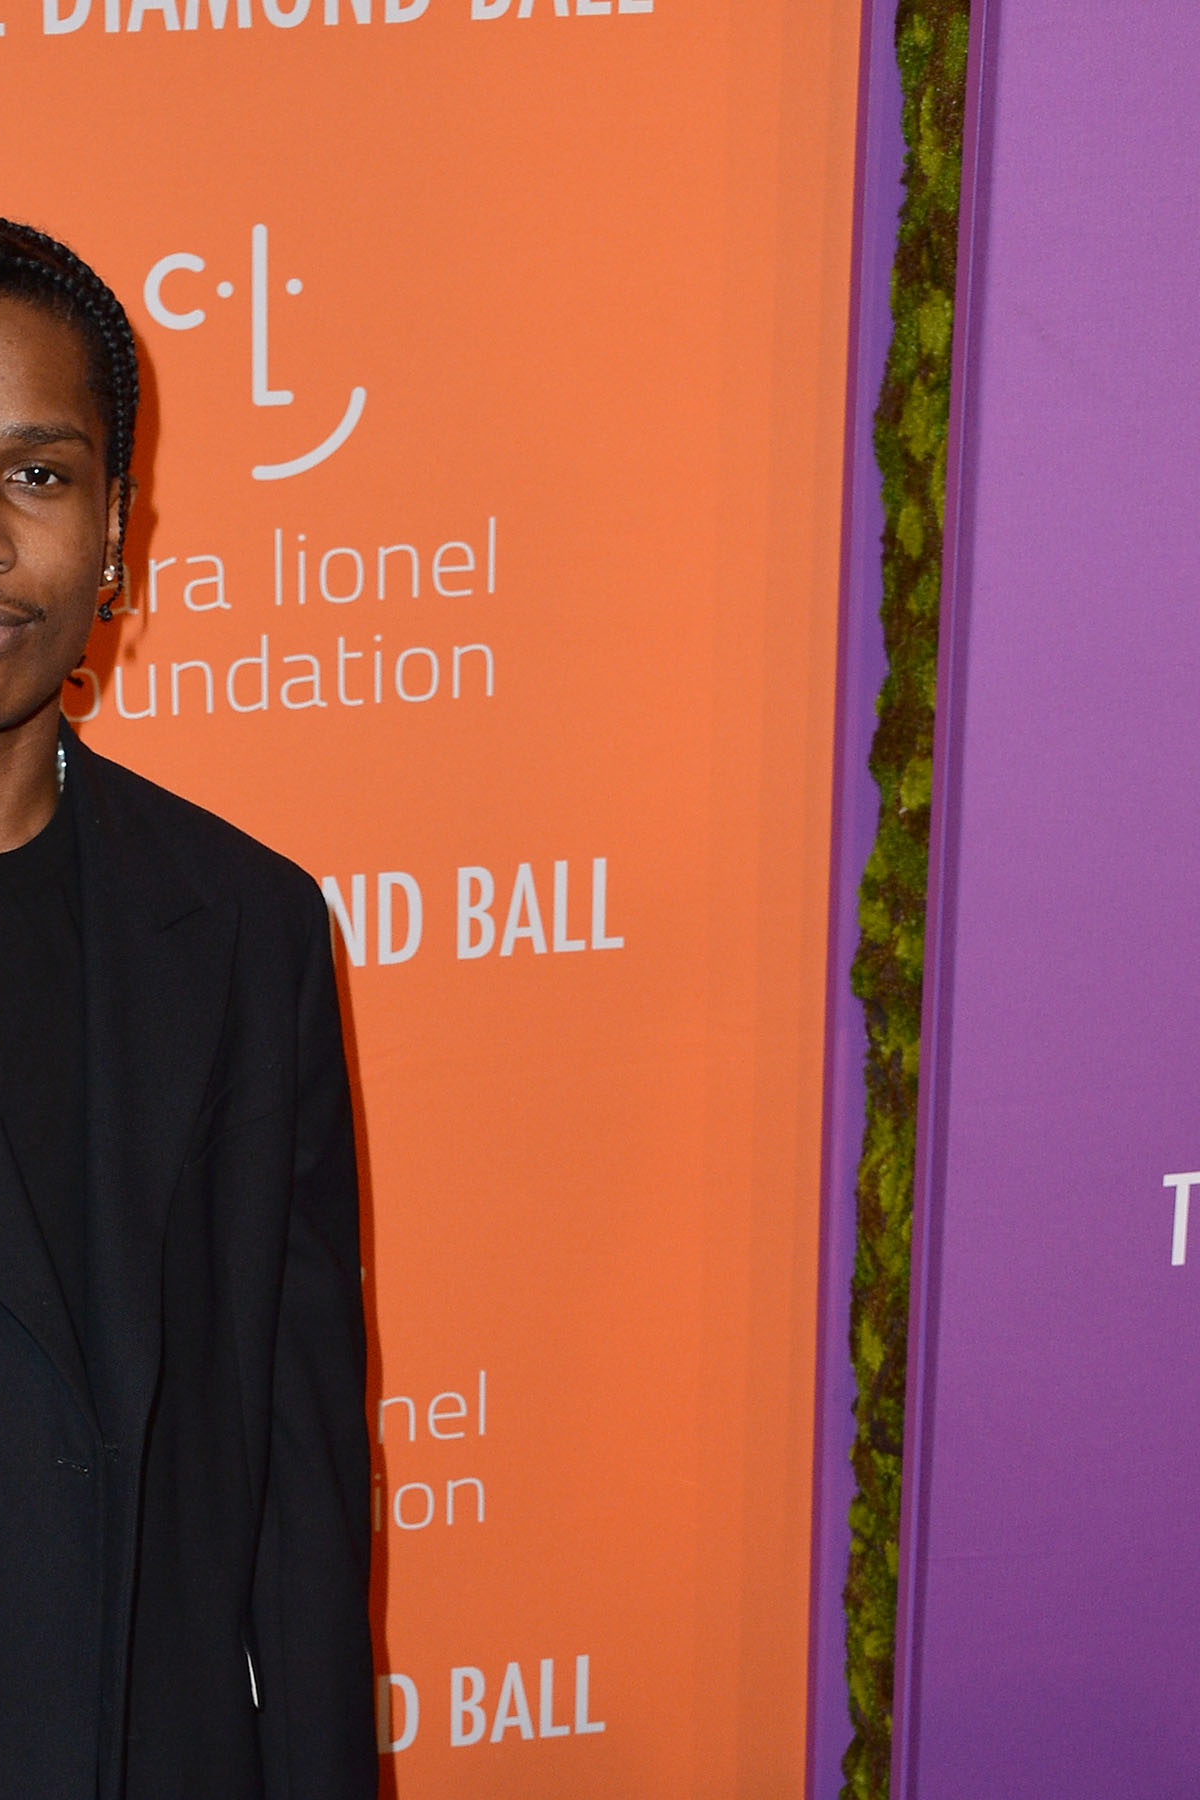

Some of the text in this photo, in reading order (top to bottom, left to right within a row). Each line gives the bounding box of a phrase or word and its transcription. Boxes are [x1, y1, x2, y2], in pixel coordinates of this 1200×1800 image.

[274, 515, 497, 606] lionel
[456, 857, 625, 960] BALL
[450, 1654, 606, 1747] BALL
